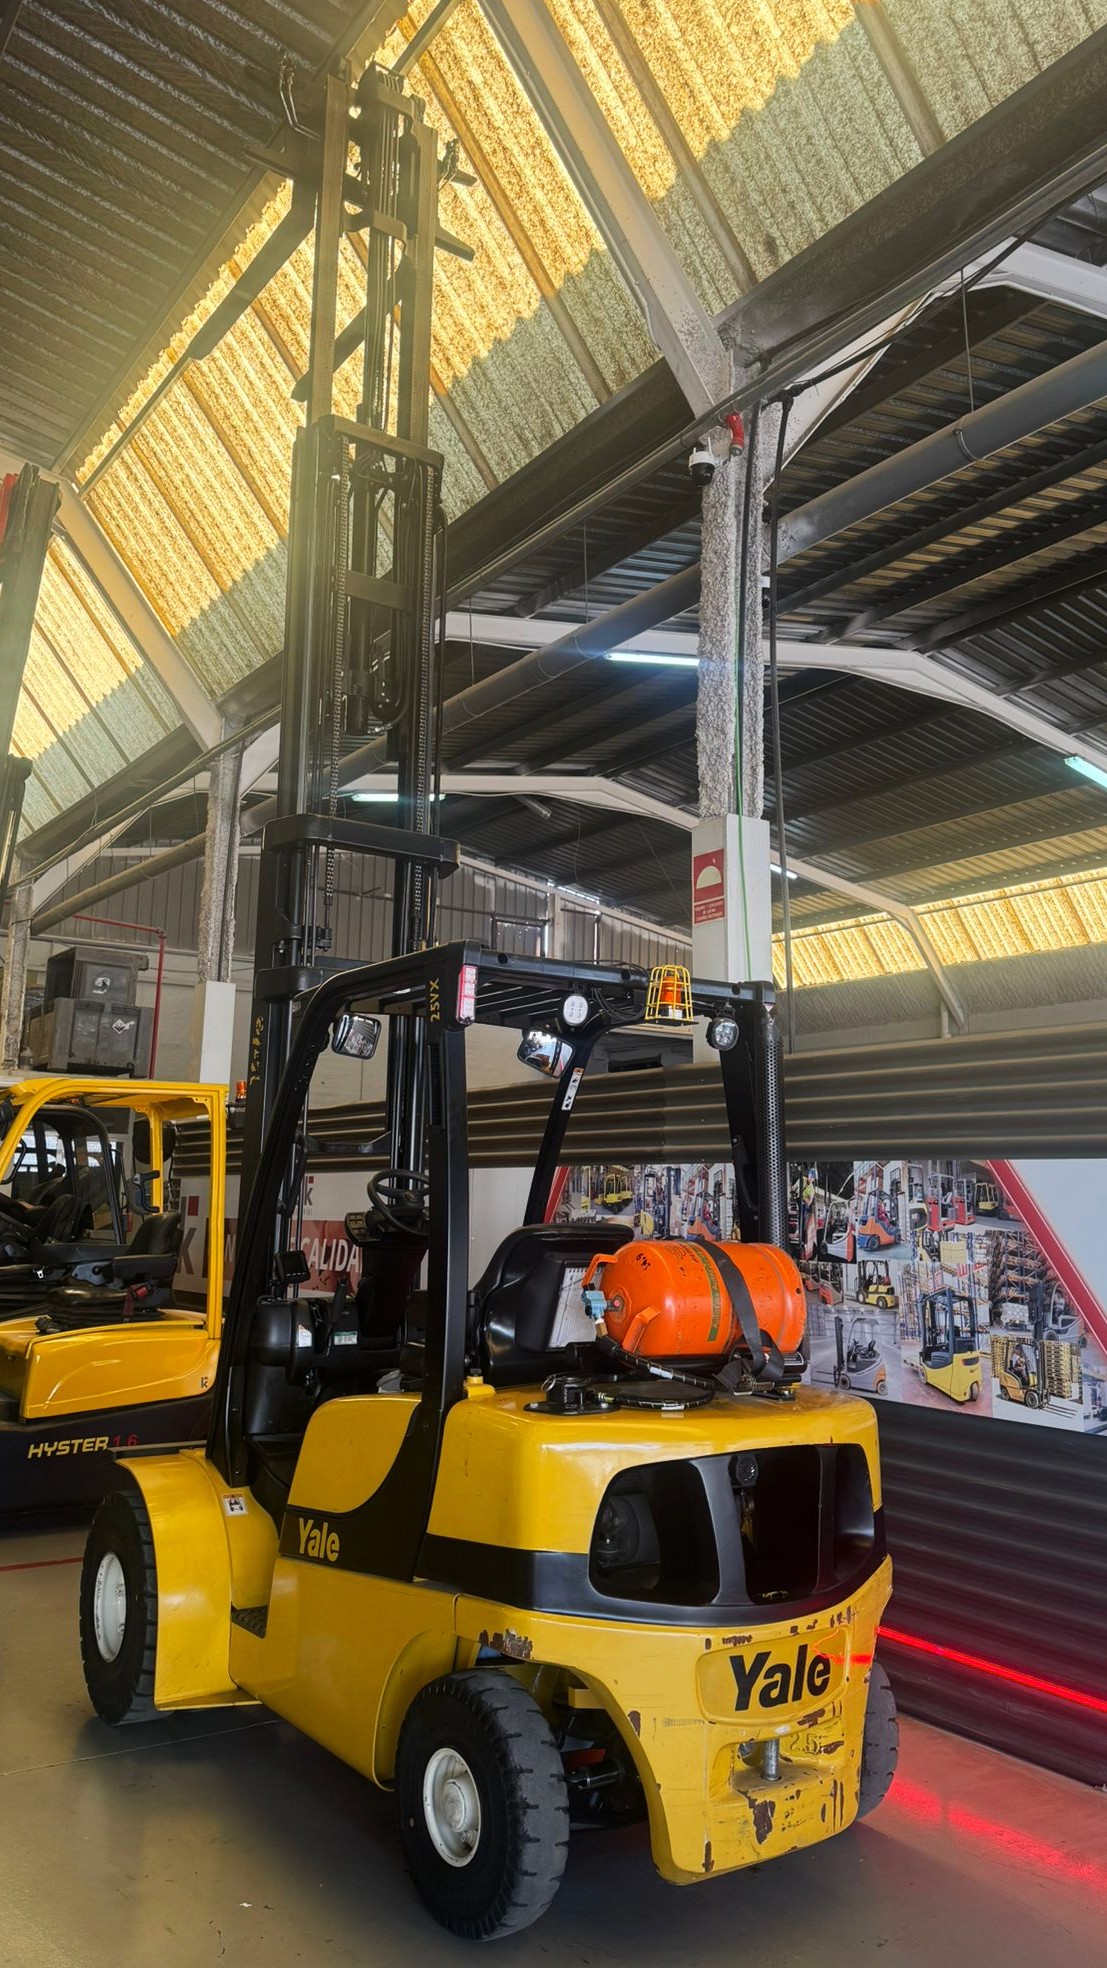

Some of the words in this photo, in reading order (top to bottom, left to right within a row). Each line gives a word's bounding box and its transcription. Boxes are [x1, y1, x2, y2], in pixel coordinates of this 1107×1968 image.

[429, 977, 440, 1022] 25VX
[27, 1436, 110, 1459] HYSTER
[112, 1433, 138, 1447] 16
[299, 1517, 340, 1562] Yale
[729, 1643, 831, 1712] Yale
